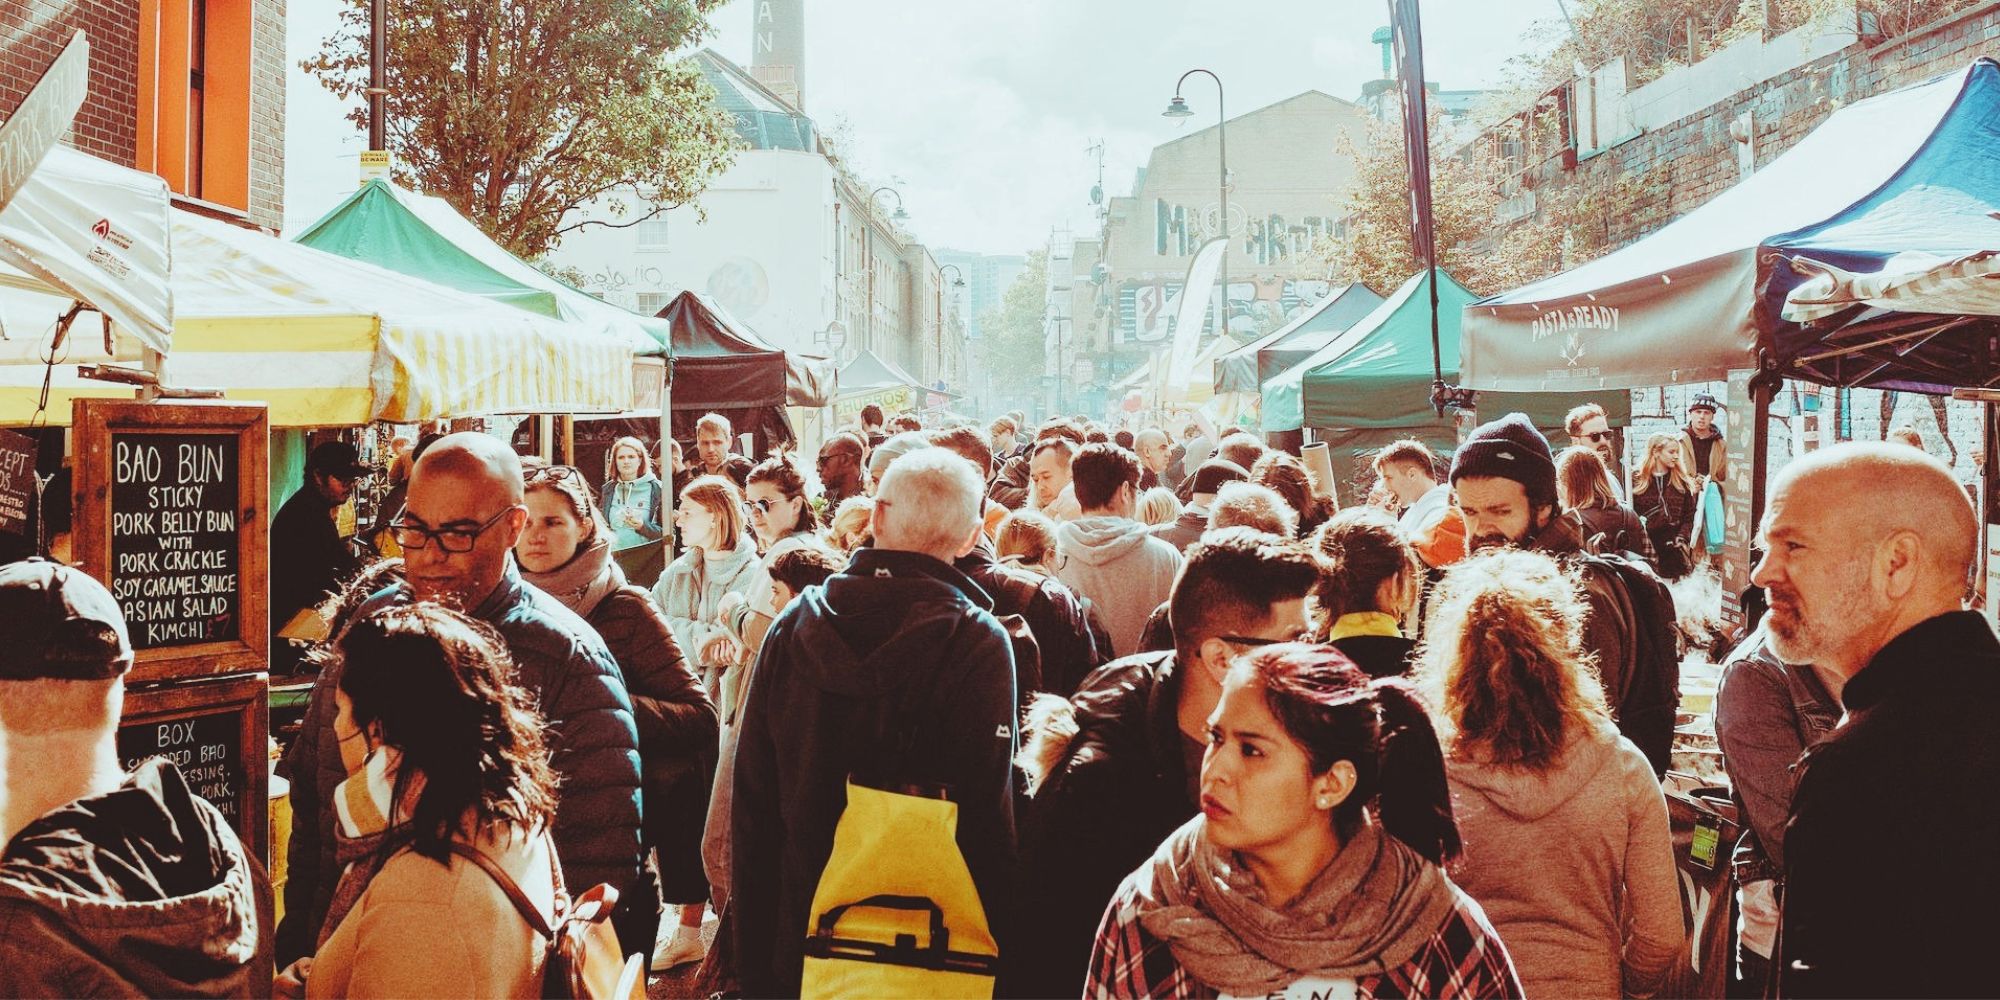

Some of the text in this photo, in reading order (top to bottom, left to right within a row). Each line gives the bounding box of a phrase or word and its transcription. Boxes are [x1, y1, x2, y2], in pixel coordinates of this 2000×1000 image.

[1532, 309, 1568, 343] PASTA
[1572, 305, 1620, 332] READY
[116, 441, 223, 484] BAO BUN
[148, 485, 203, 509] STICKY
[113, 509, 235, 536] PORK BELLY BUN
[158, 536, 193, 550] WITH
[119, 549, 227, 573] PORK CRACKLE
[113, 573, 237, 600] SOY CARAMEL SAUCE
[123, 596, 228, 622] ASIAN SALAD
[147, 621, 203, 645] KIMCHI
[157, 720, 195, 748] BOX
[200, 743, 226, 763] BAO
